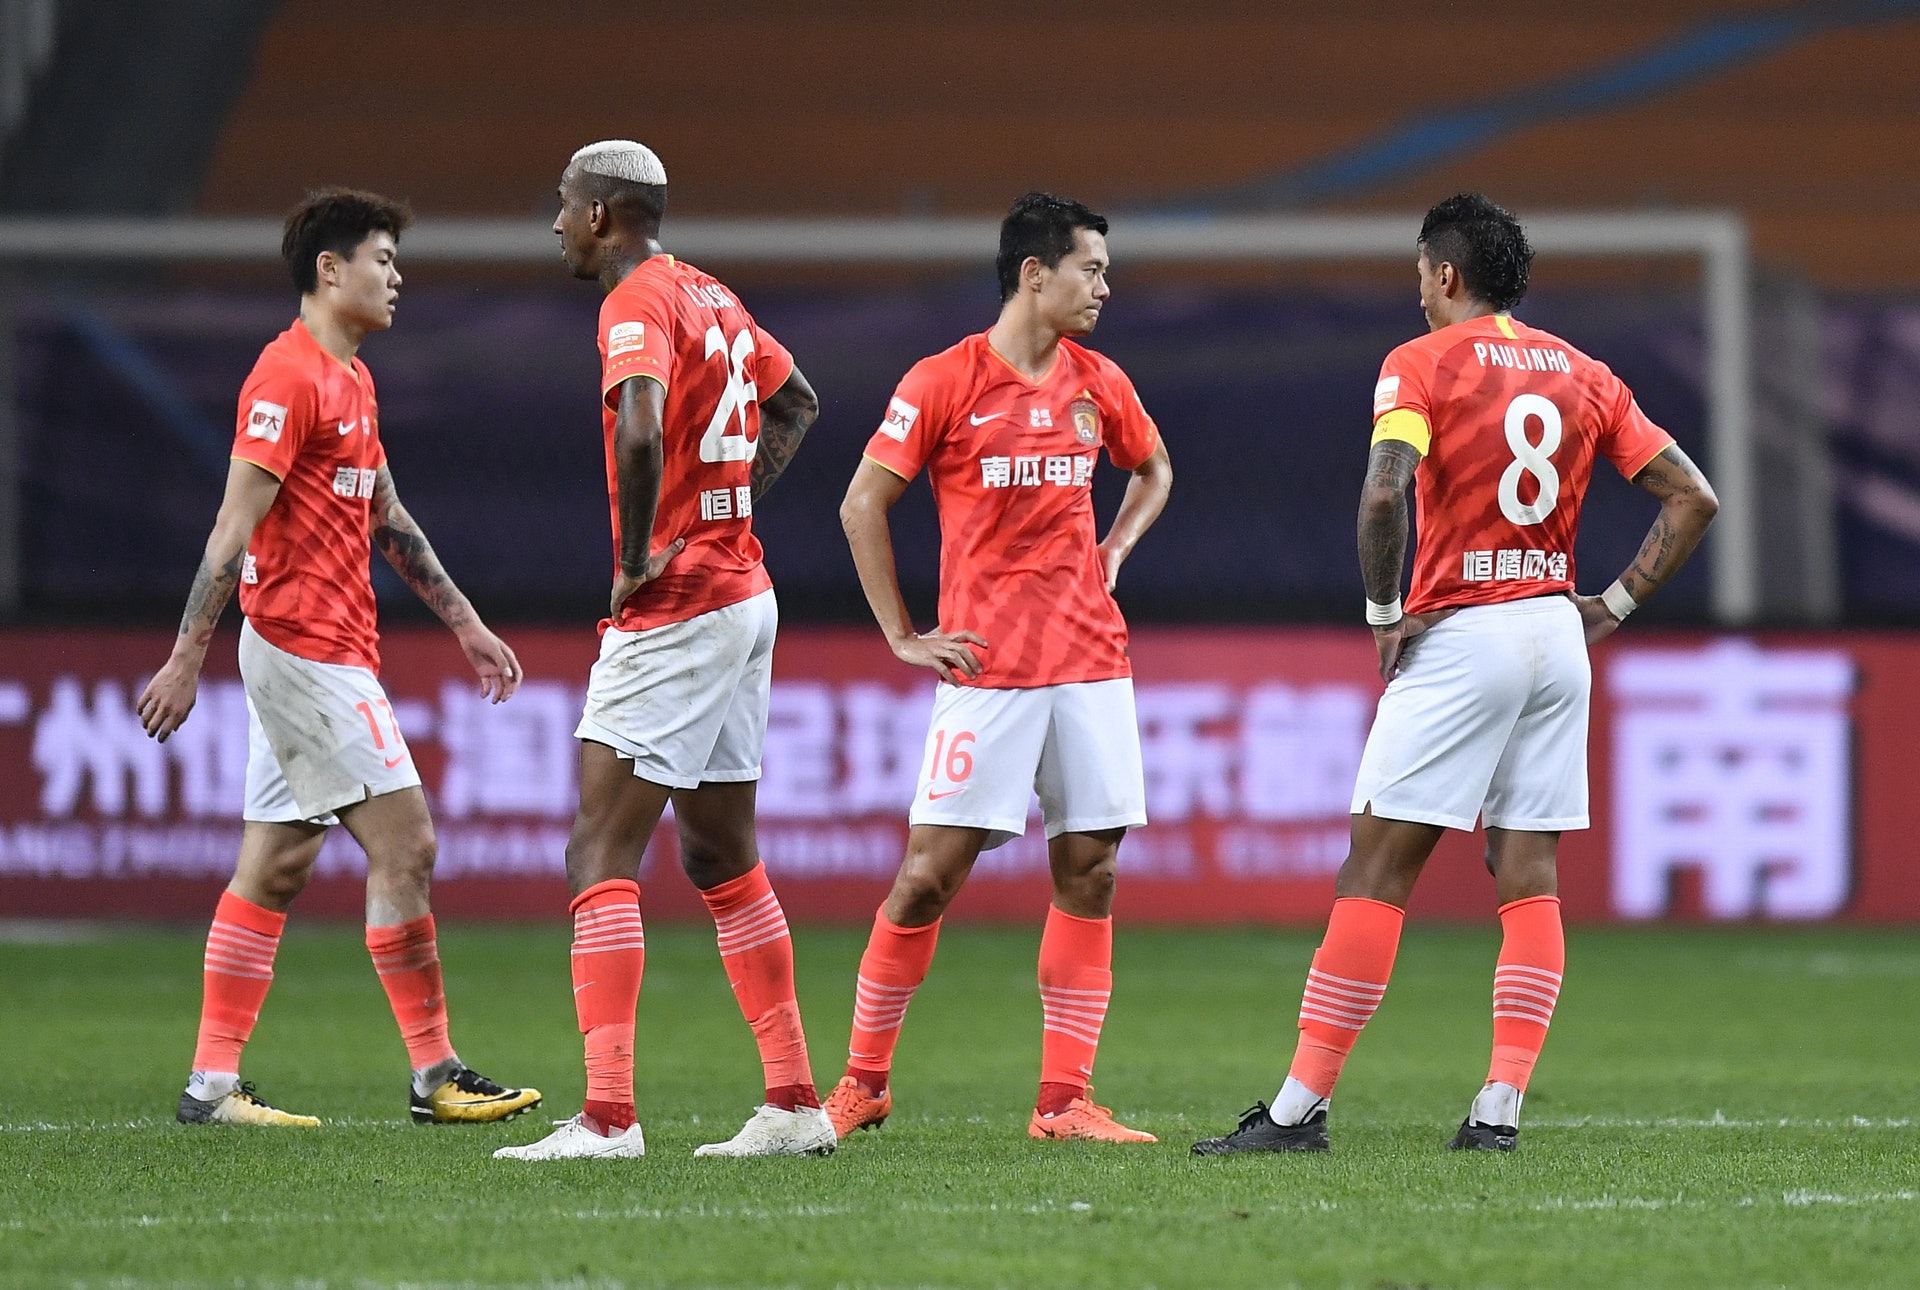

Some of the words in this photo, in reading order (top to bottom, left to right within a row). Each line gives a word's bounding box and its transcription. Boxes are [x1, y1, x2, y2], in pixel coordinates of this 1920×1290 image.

[1473, 342, 1571, 374] PAULINHO
[980, 456, 1094, 488] 南瓜电影
[1497, 393, 1562, 526] 8
[1462, 548, 1568, 582] 恒腾网络
[930, 729, 976, 783] 16
[1607, 637, 1852, 918] 南
